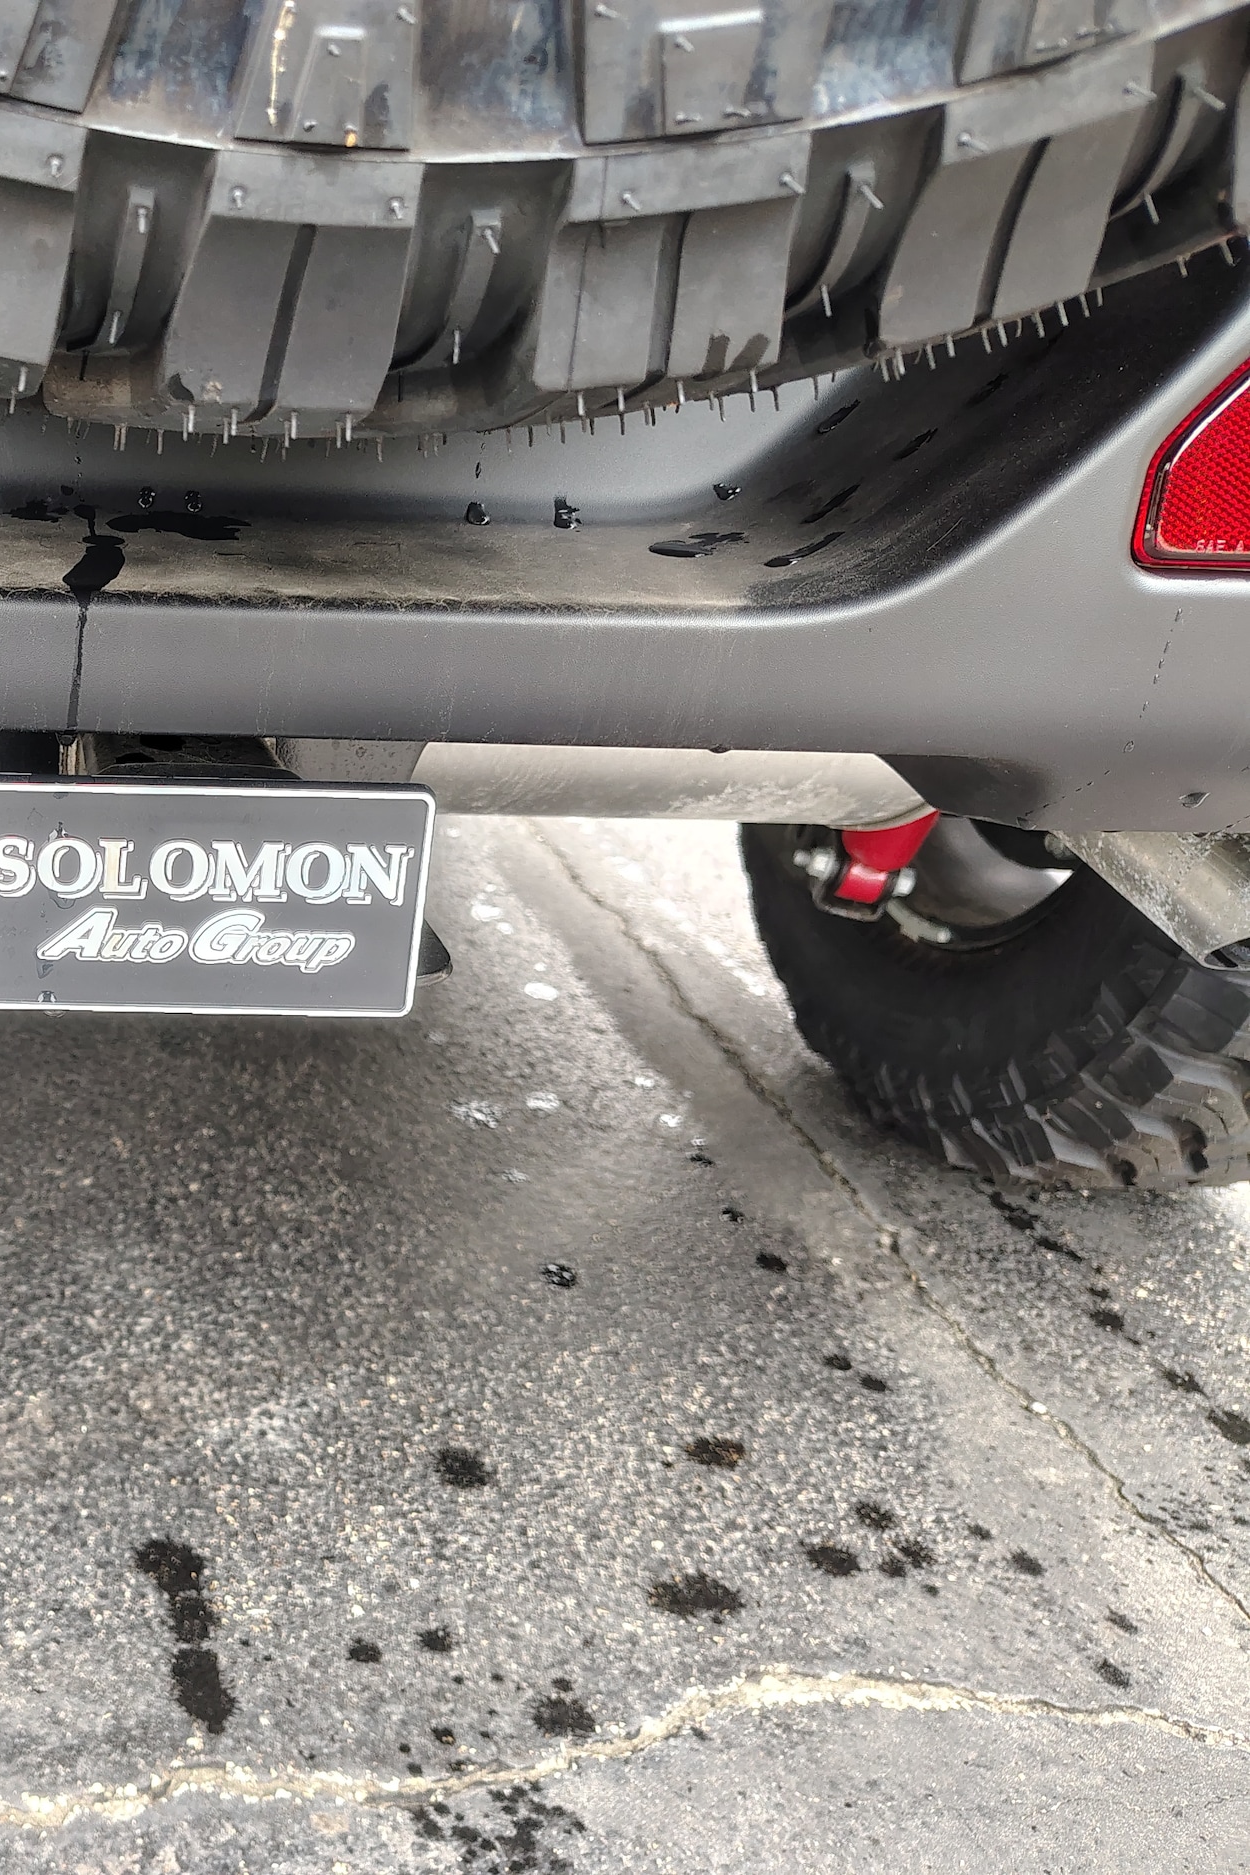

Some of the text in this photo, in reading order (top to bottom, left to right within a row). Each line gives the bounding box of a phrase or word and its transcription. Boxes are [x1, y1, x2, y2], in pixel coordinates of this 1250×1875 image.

[1196, 539, 1245, 553] SAE A
[37, 906, 356, 974] Auto Group
